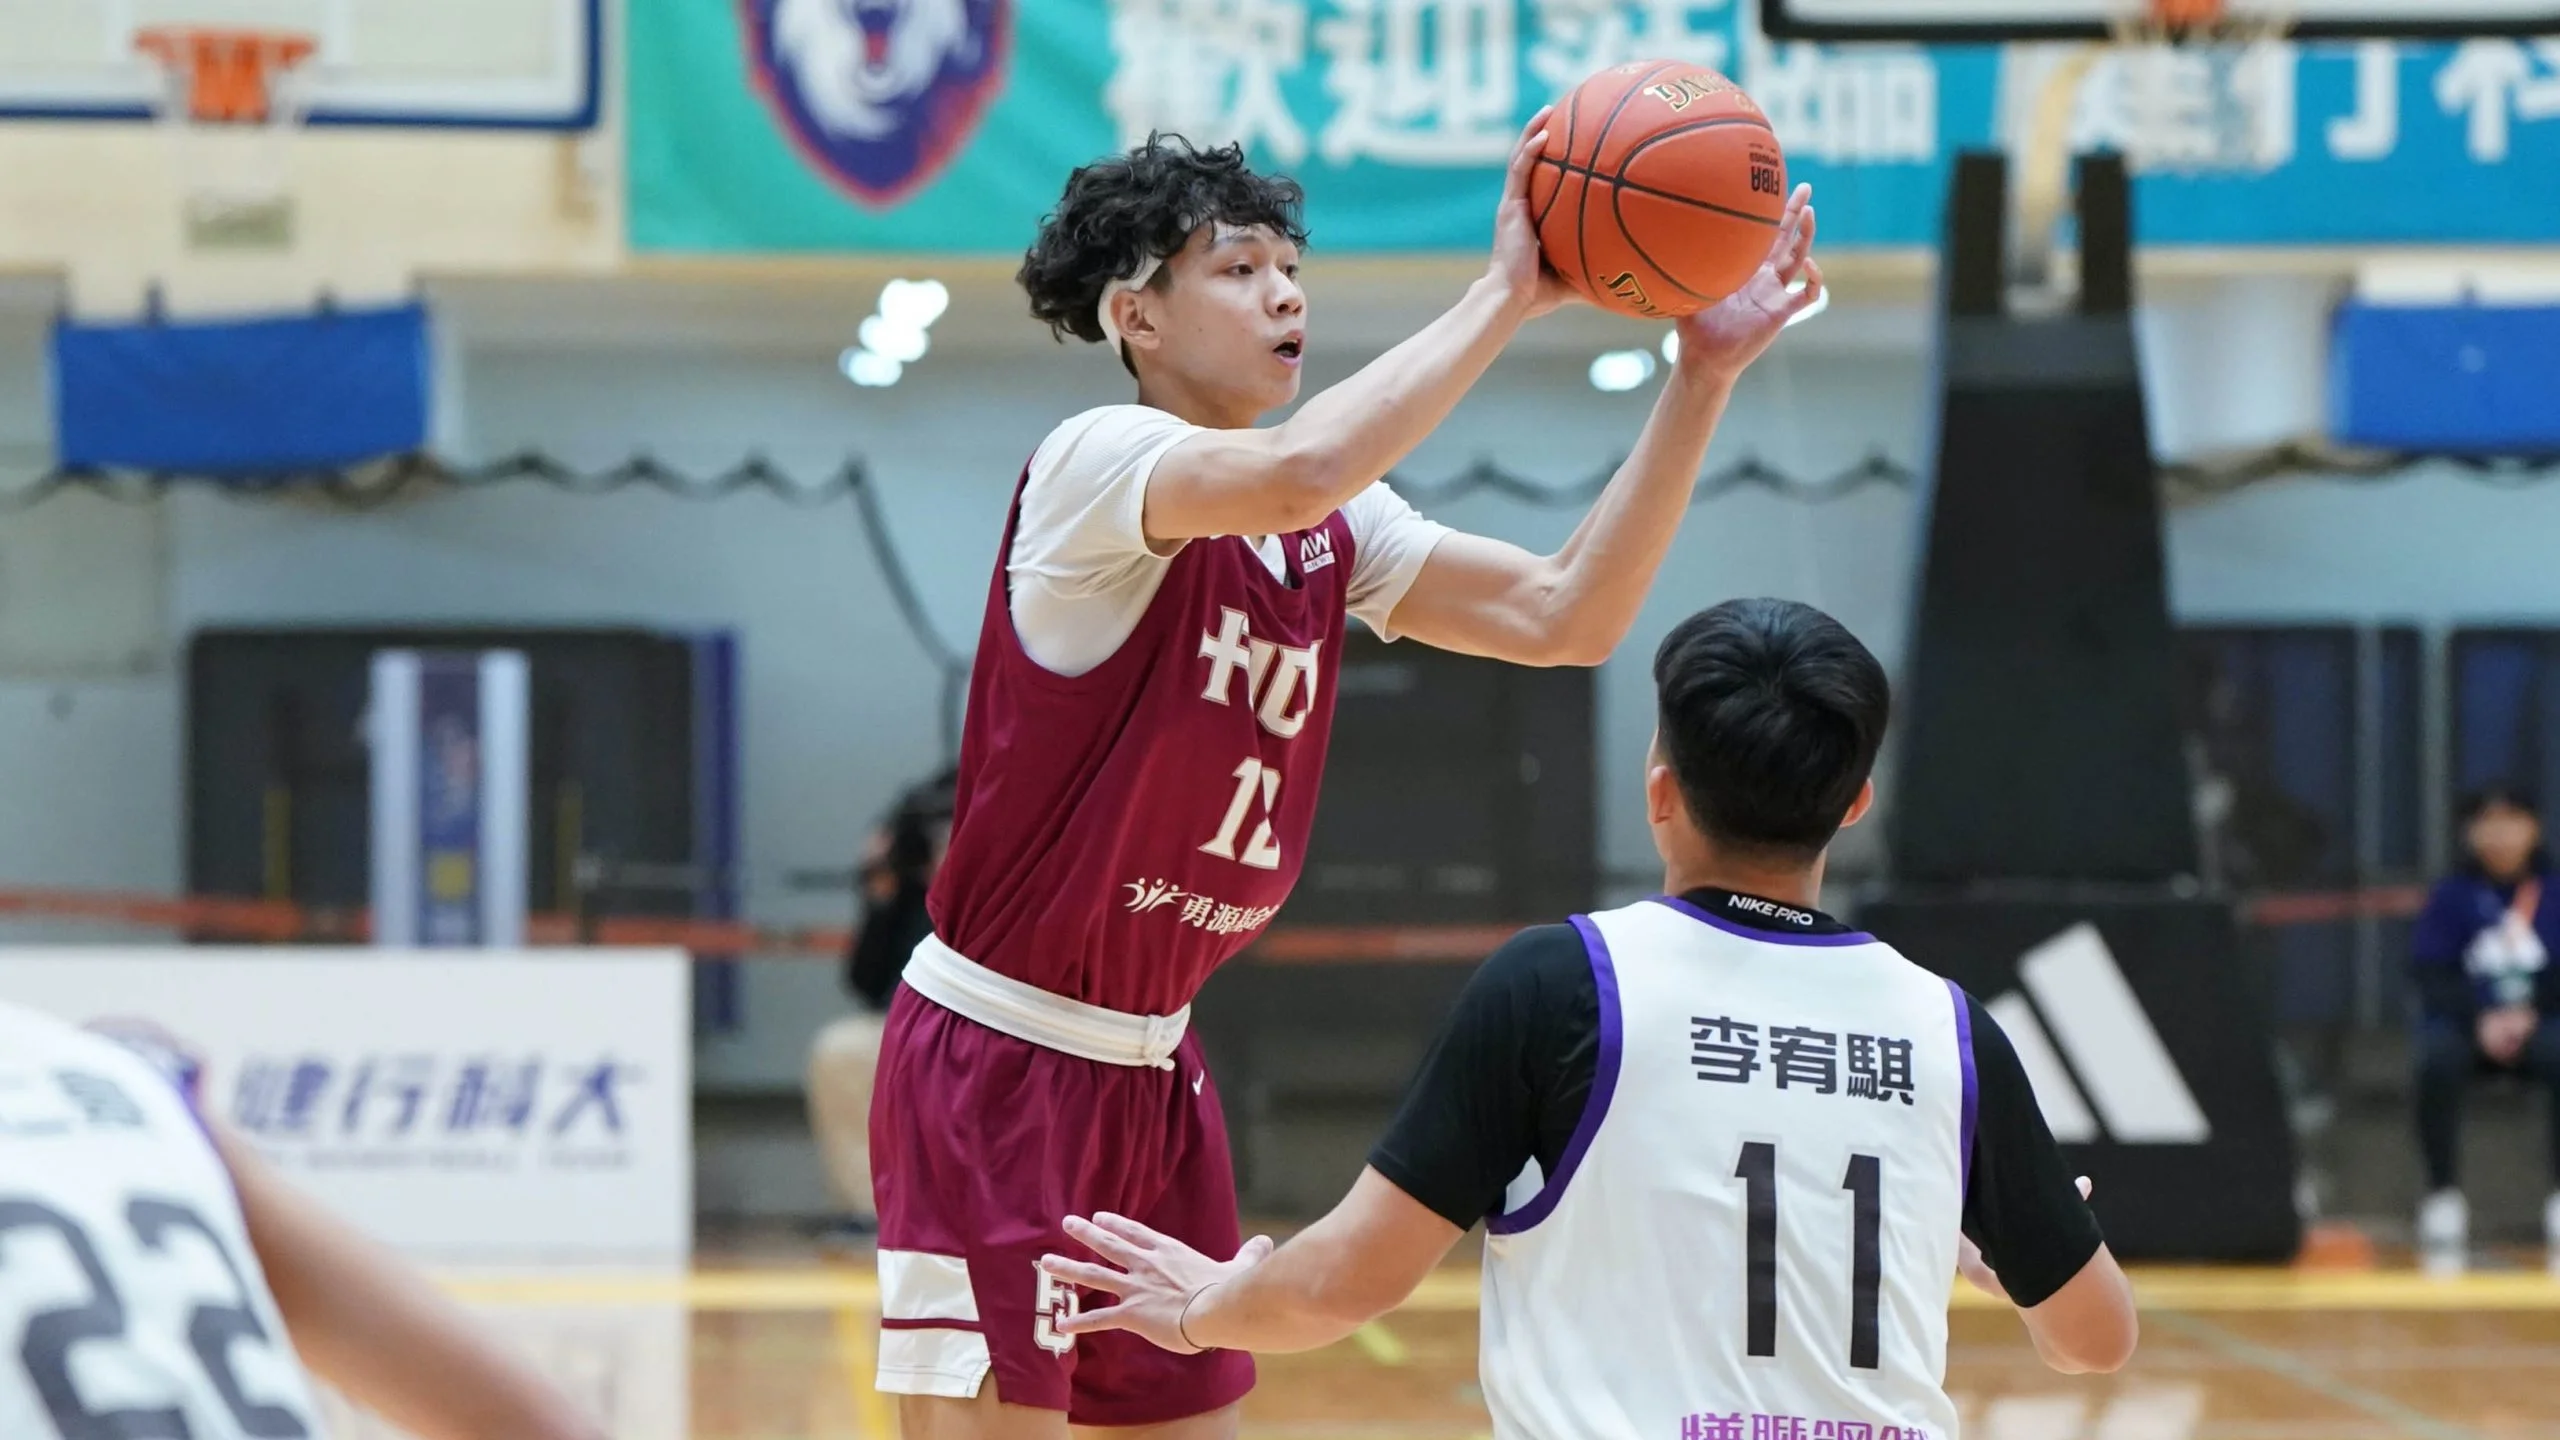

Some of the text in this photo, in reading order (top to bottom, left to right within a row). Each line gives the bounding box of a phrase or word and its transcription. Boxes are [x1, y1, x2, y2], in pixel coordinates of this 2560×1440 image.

[1751, 165, 1781, 198] FIBA
[1727, 894, 1814, 926] NIKE PRO
[1690, 1016, 1915, 1105] 李宥騏
[1732, 1138, 1882, 1371] 11
[0, 1194, 314, 1440] 22
